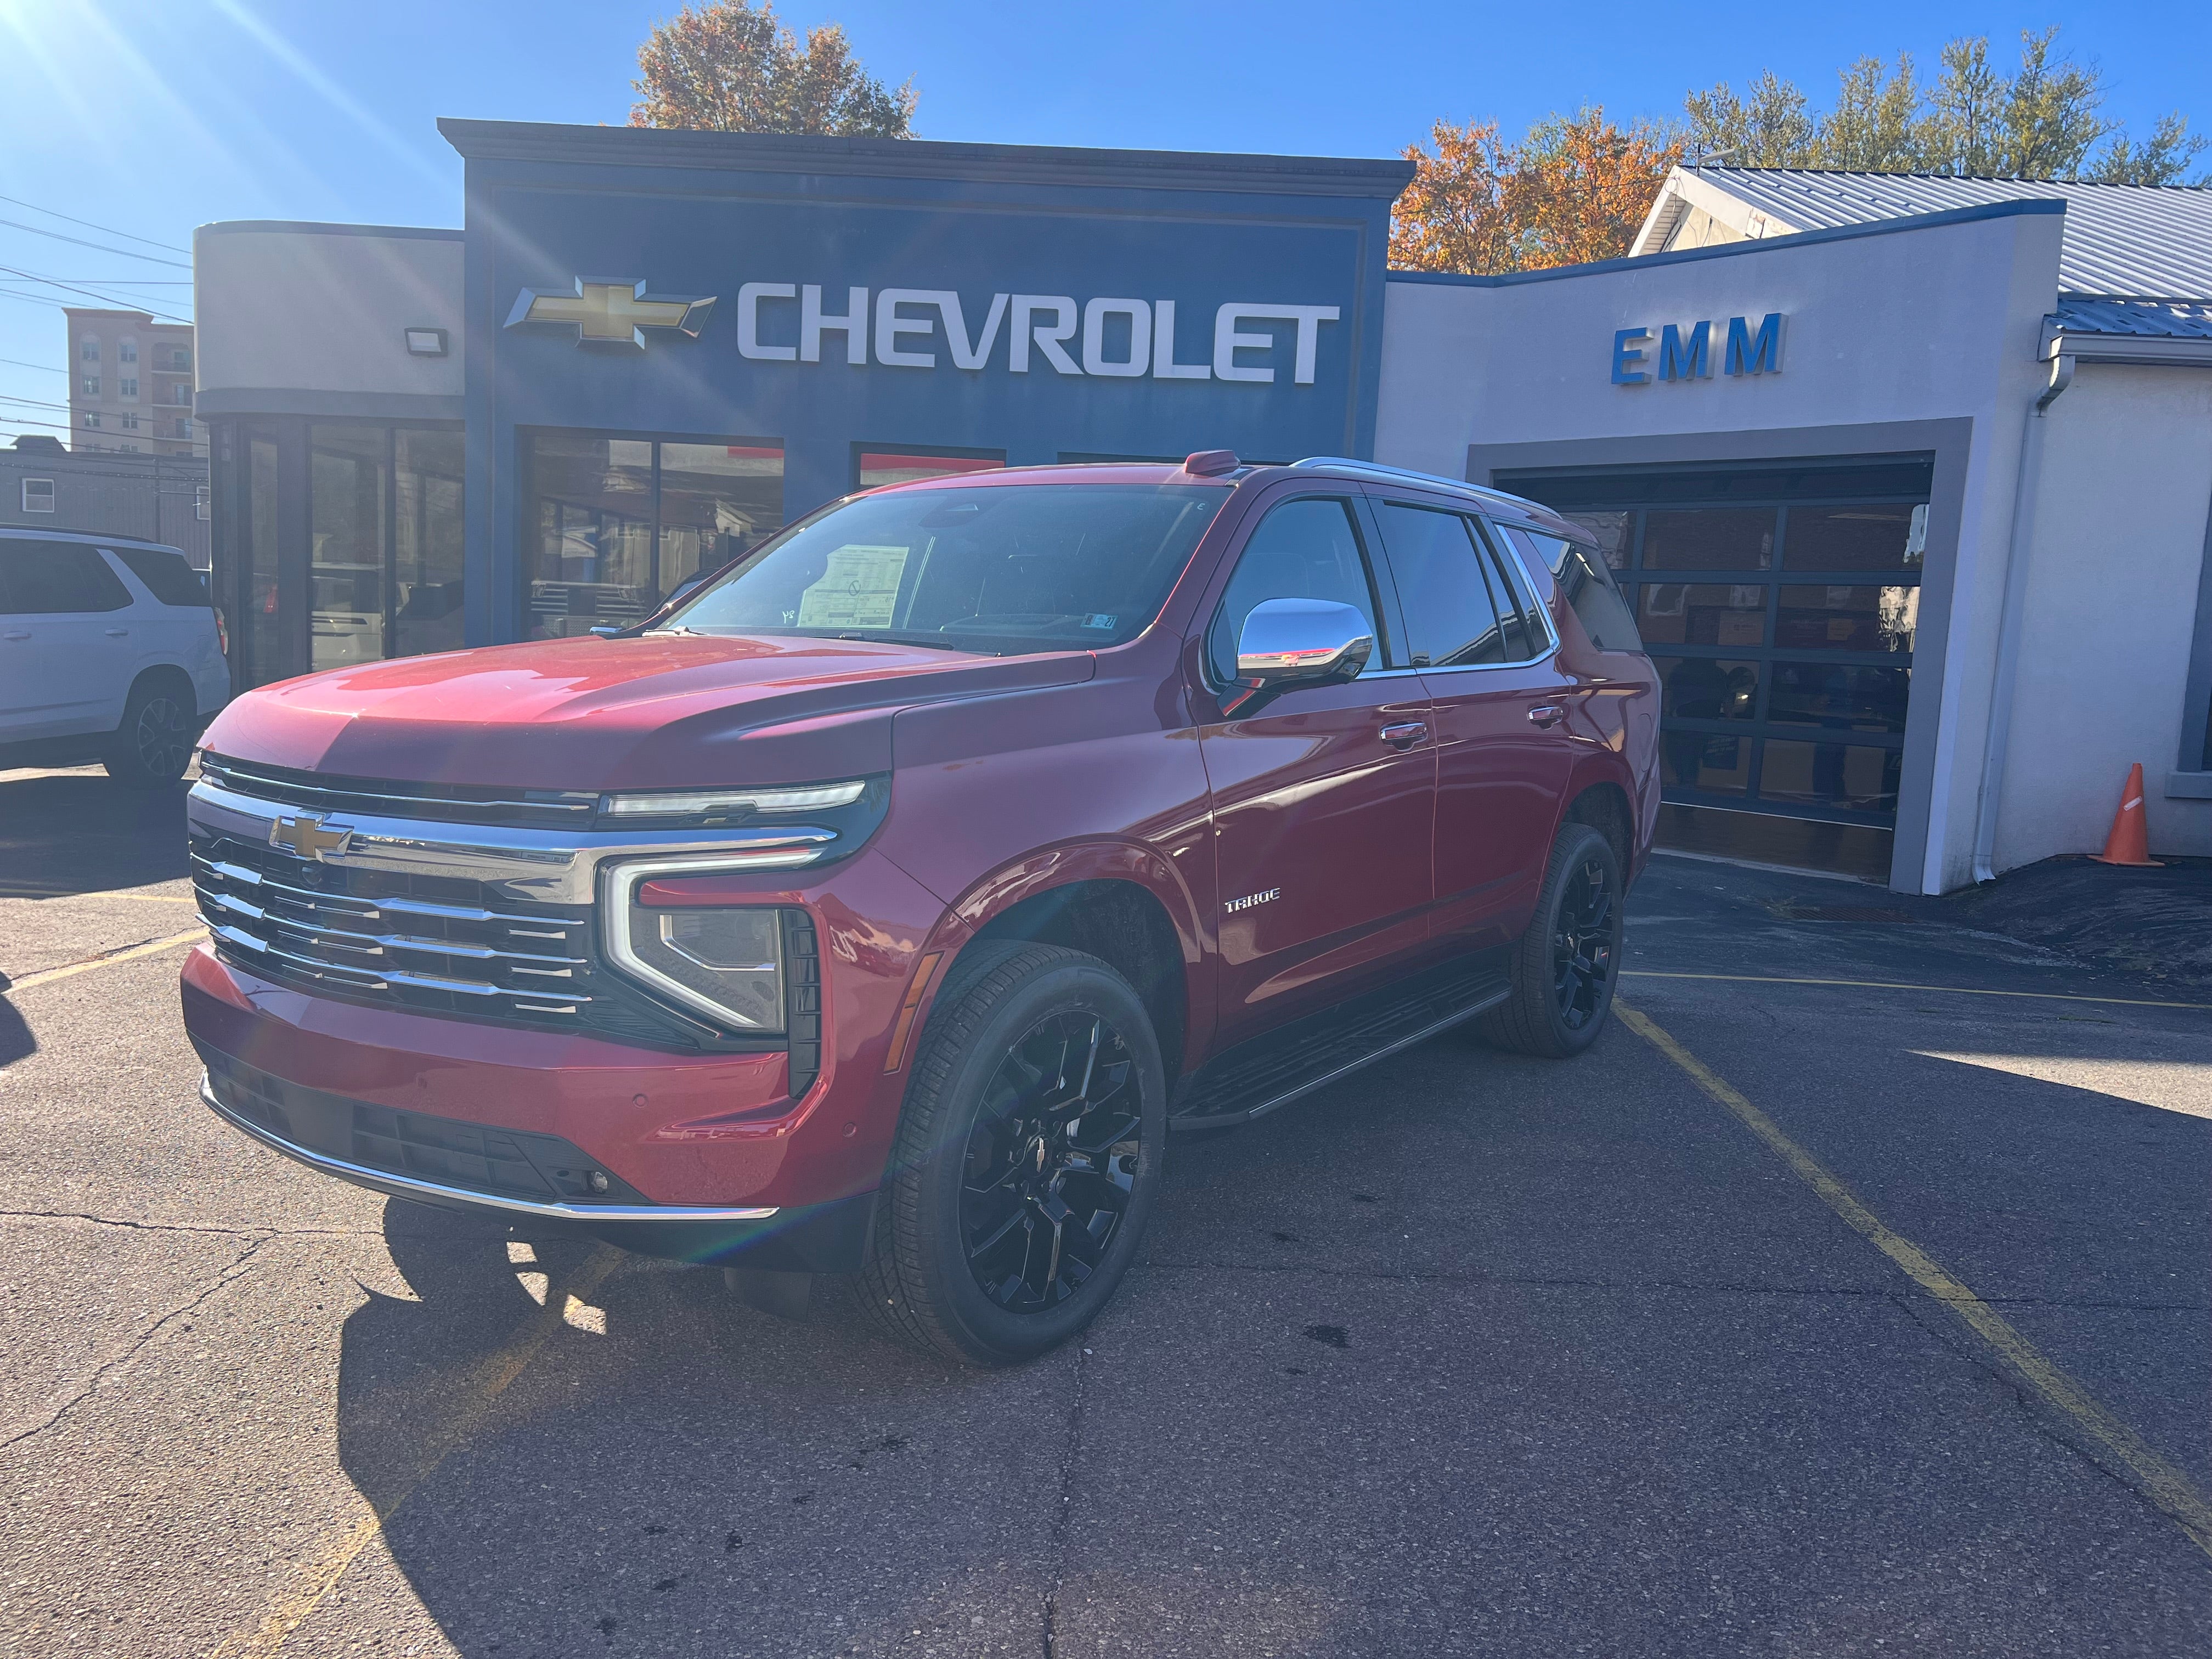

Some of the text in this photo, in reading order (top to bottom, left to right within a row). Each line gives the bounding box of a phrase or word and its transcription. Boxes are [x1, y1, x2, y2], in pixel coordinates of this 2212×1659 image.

[737, 283, 1340, 383] CHEVROLET
[1611, 313, 1787, 385] EMM
[1104, 617, 1115, 628] 27
[1224, 887, 1280, 913] TAHOE
